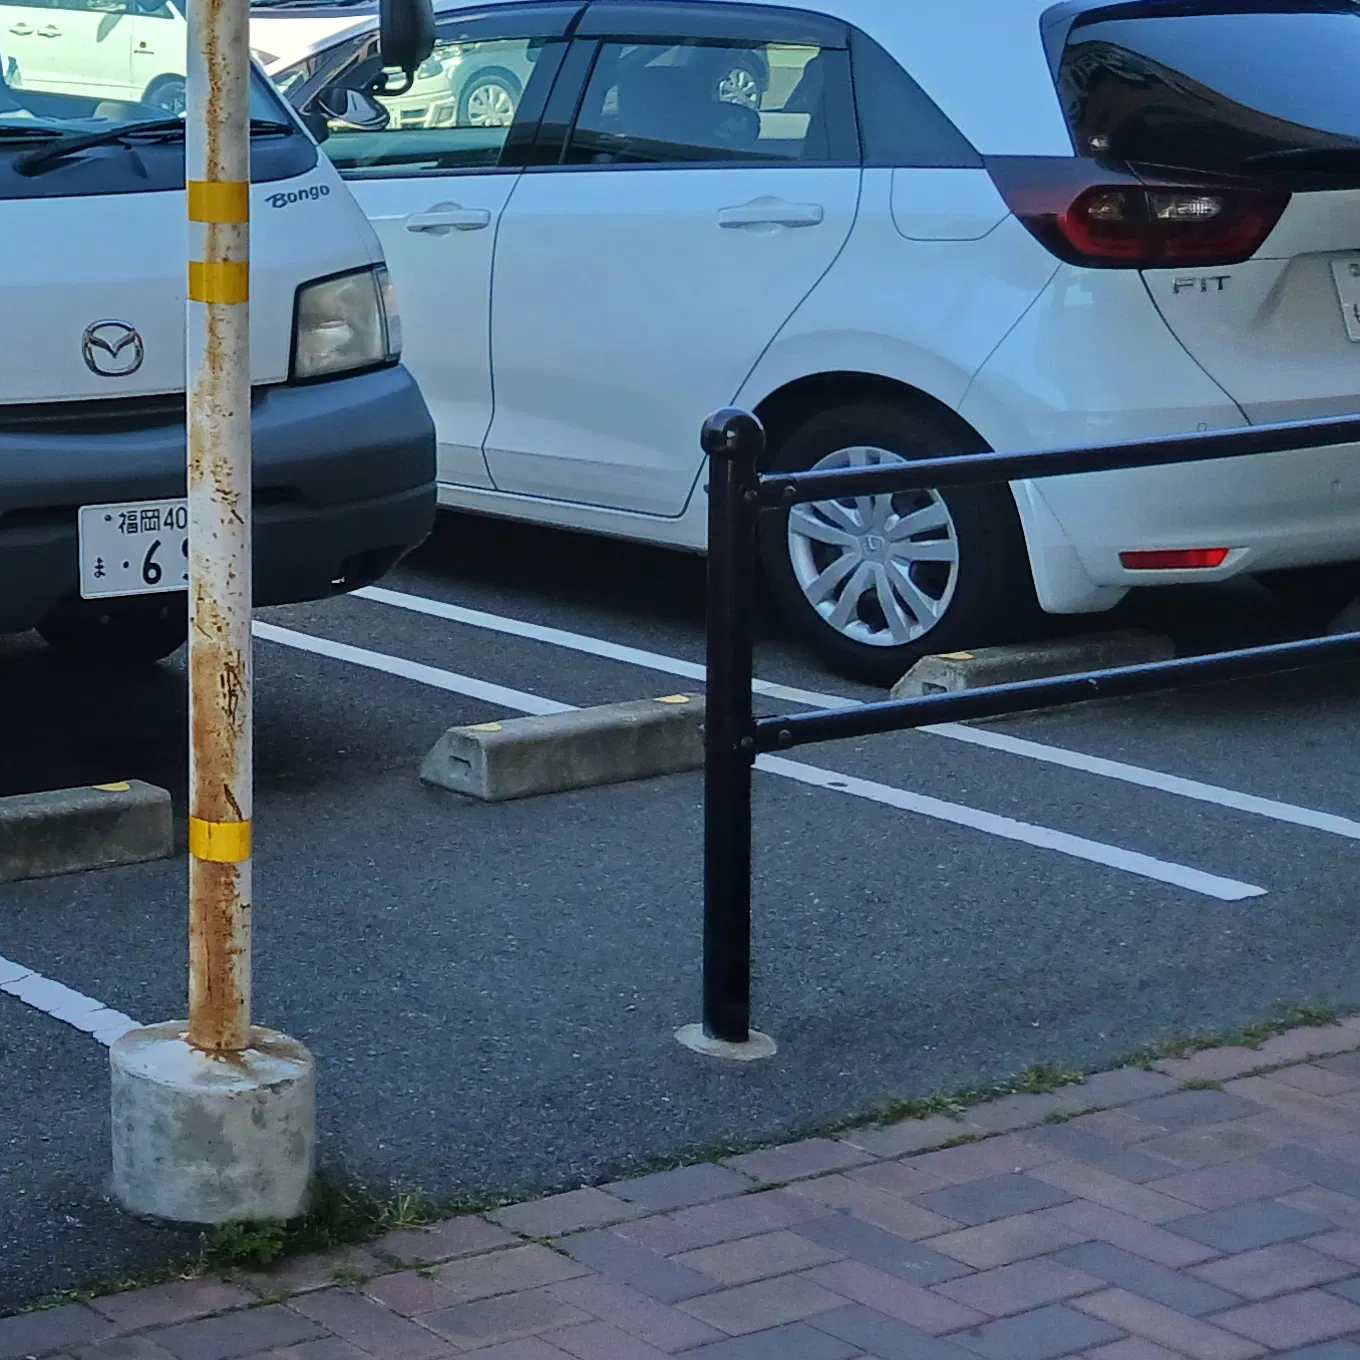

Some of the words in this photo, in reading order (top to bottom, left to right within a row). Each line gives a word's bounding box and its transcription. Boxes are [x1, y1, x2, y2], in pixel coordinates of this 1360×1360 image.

[264, 182, 331, 209] Bongo
[1172, 275, 1231, 294] FIT
[118, 506, 188, 534] 福岡40
[93, 556, 106, 578] ま
